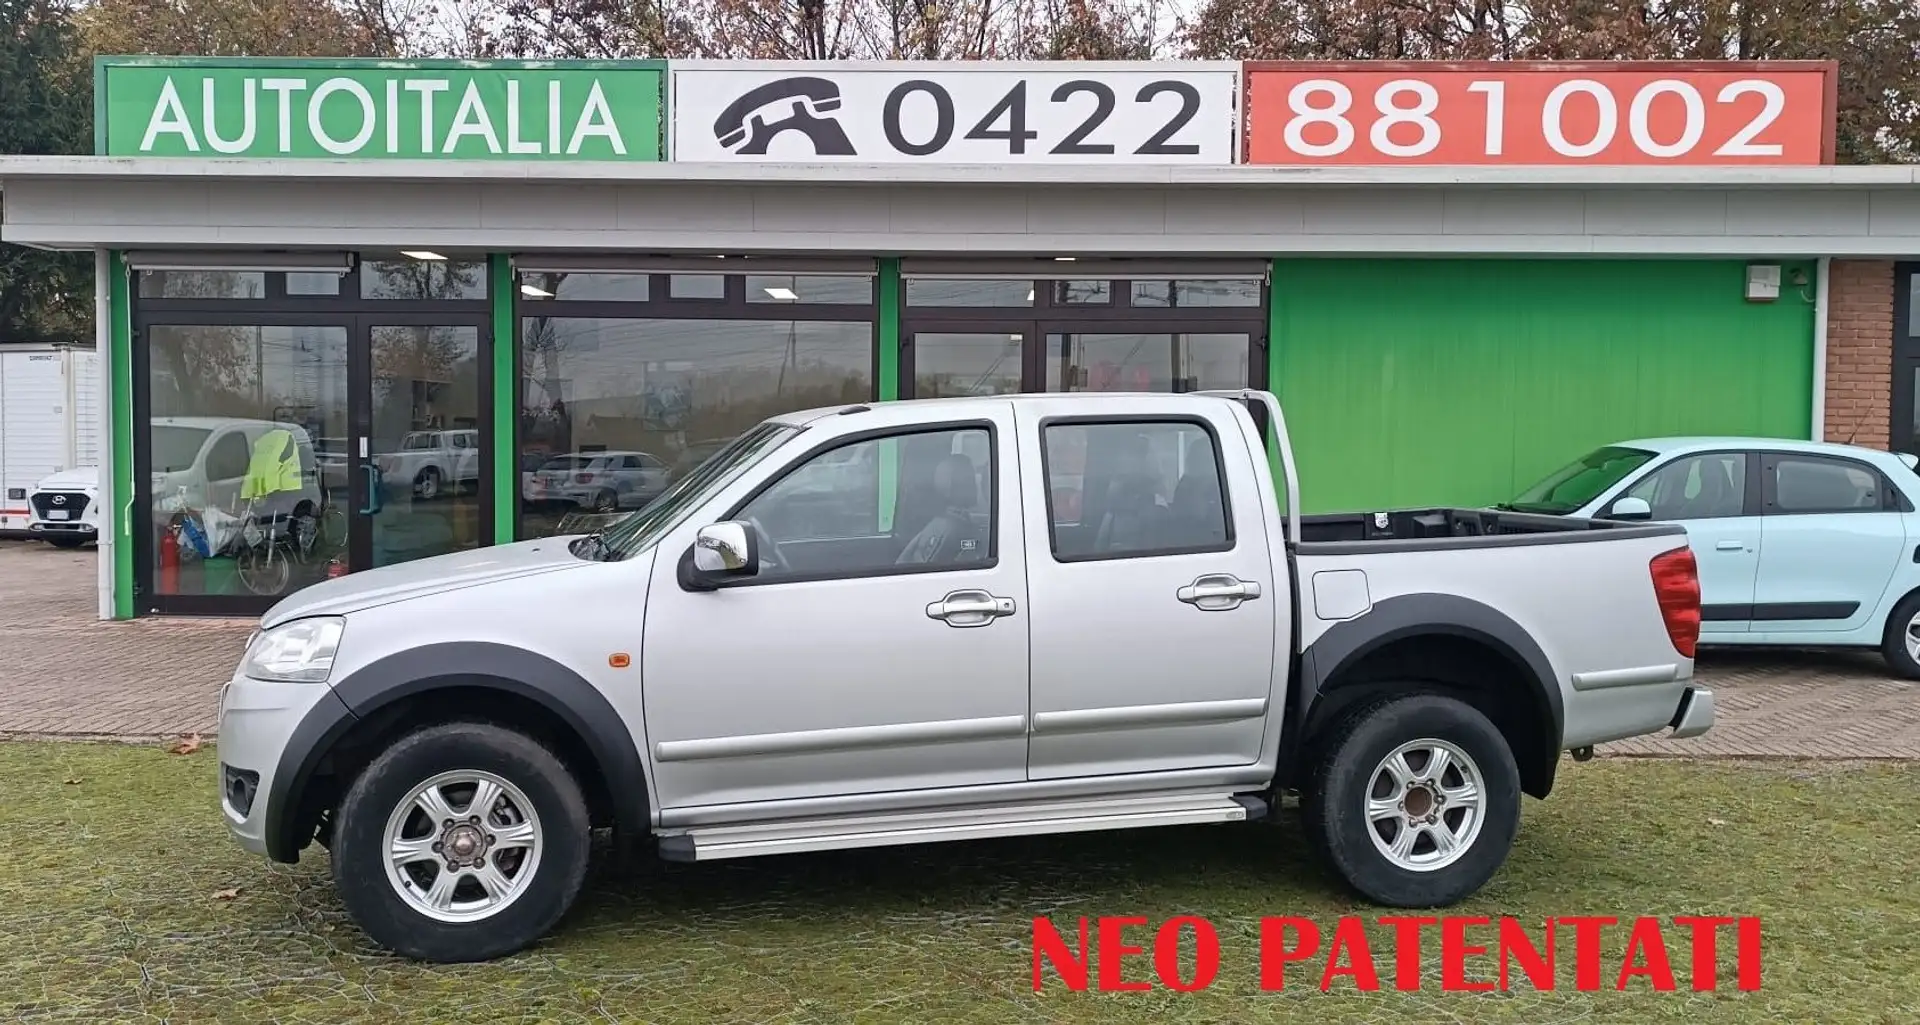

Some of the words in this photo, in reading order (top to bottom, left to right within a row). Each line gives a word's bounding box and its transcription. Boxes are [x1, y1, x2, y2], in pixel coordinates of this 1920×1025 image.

[140, 77, 626, 155] AUTOITALIA
[883, 80, 1201, 155] 0422
[1283, 79, 1785, 157] 881002
